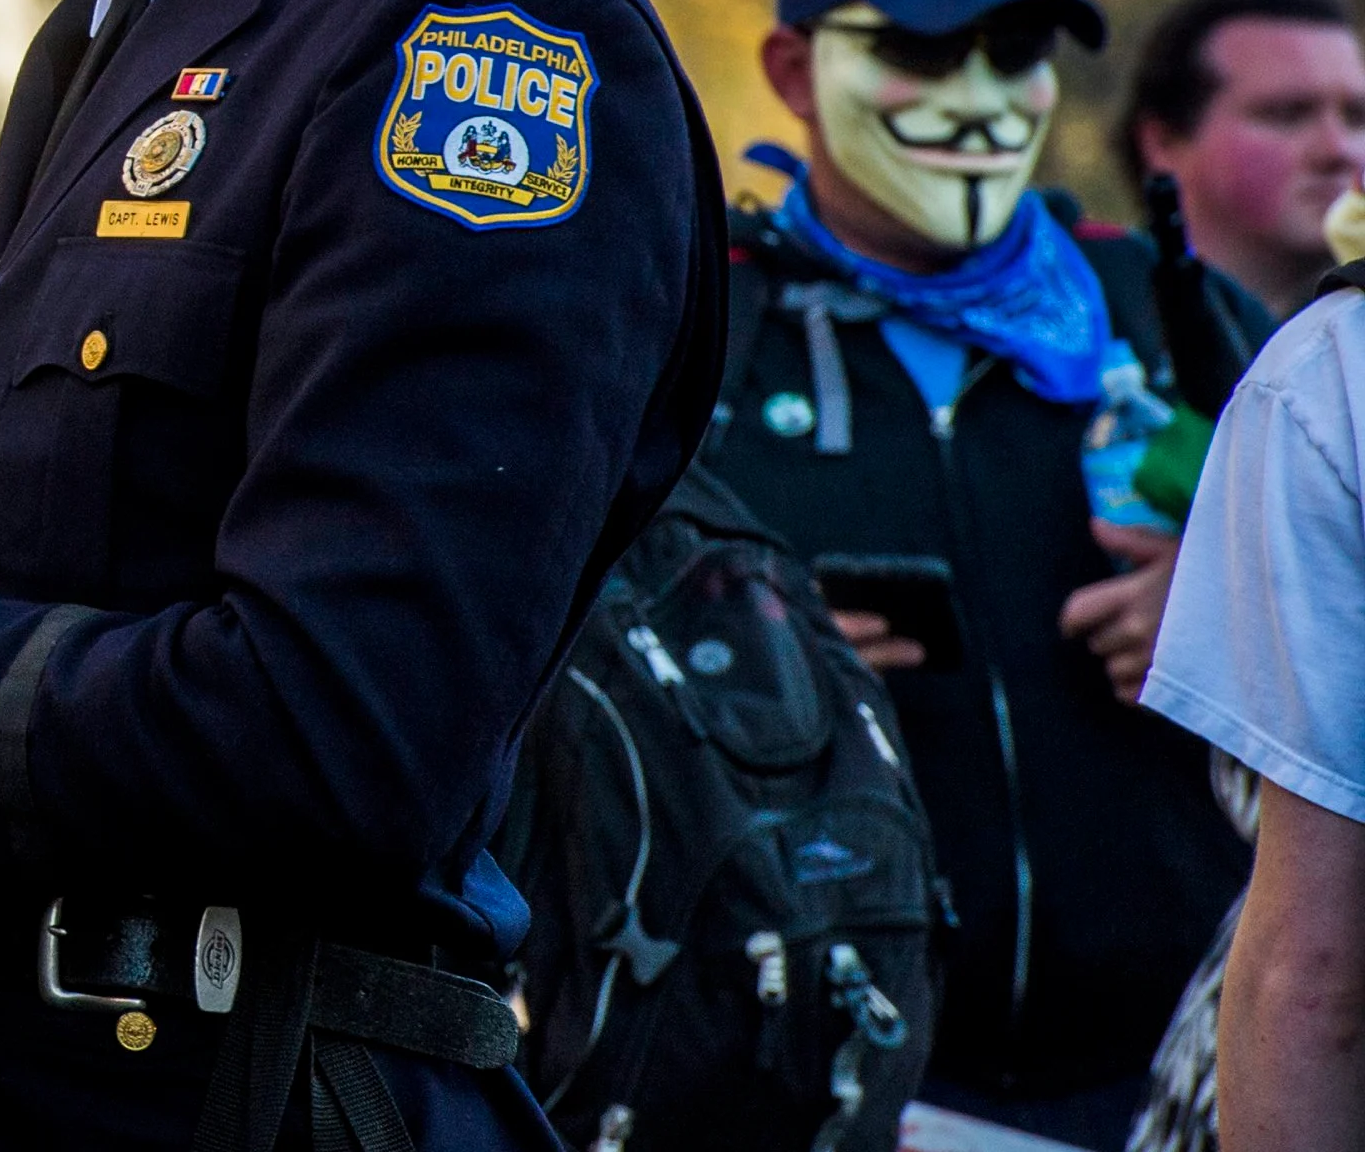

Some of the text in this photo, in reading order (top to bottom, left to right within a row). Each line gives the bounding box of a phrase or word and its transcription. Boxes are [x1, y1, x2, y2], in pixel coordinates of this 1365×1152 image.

[420, 30, 582, 77] PHILADELPHIA
[411, 50, 578, 129] POLICE
[396, 155, 438, 167] HONOR
[449, 177, 515, 199] INTEGRITY
[527, 174, 568, 198] SERVICE
[108, 212, 180, 226] CAPT. LEWIS
